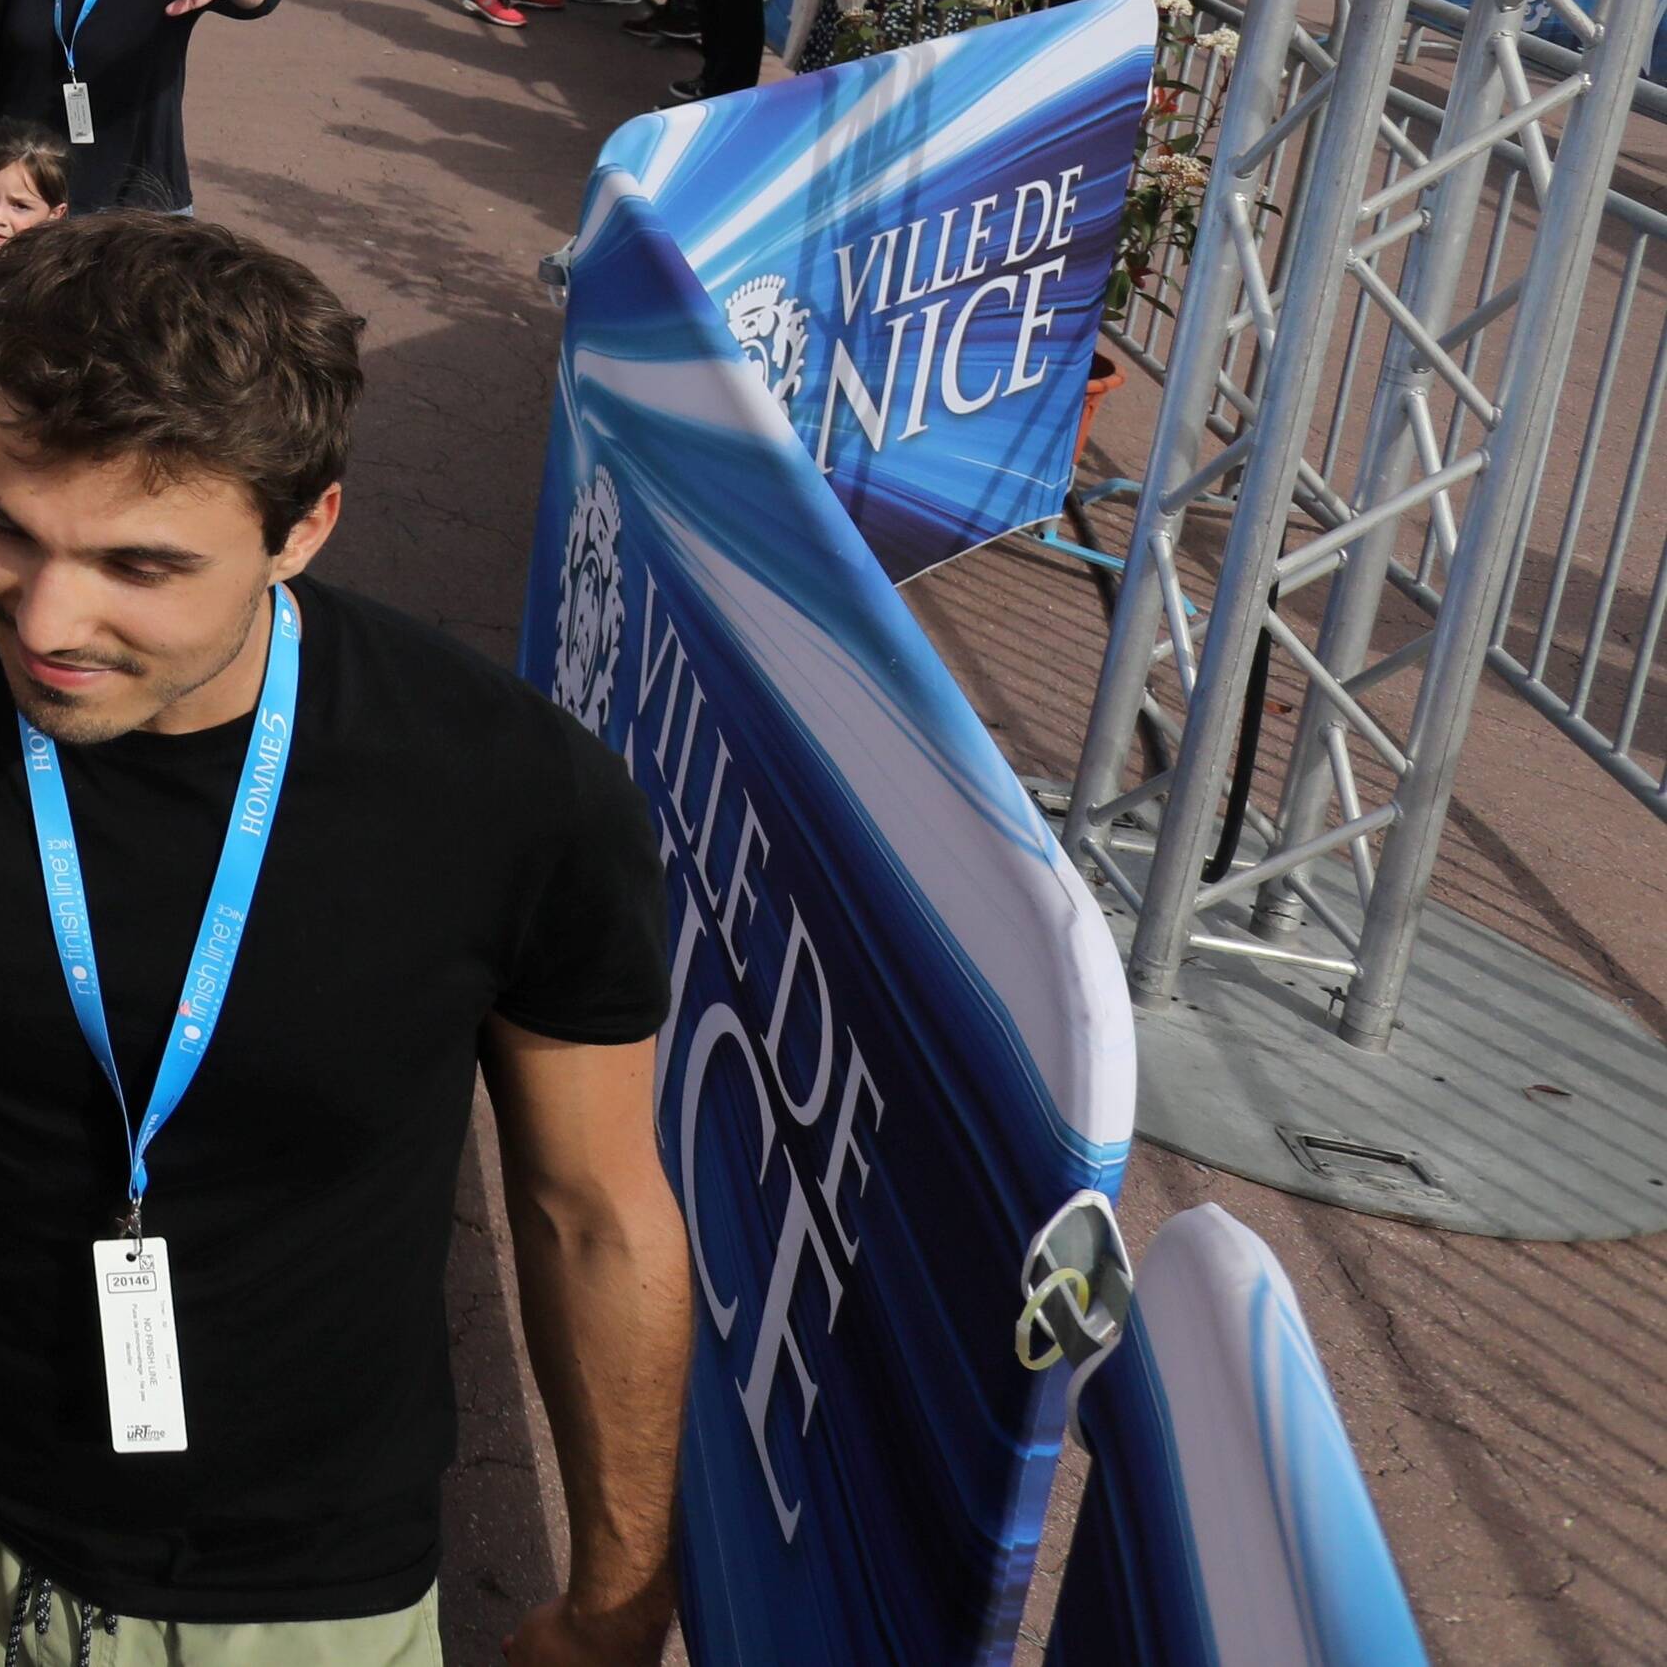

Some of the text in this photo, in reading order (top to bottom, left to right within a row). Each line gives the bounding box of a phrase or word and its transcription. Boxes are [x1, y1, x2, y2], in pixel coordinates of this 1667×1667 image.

[832, 164, 1085, 329] VILLE DE
[816, 255, 1067, 478] NICE
[240, 706, 288, 836] HOMME 5
[634, 562, 771, 982] VILLE
[45, 835, 72, 852] NICE
[45, 855, 91, 996] no finish line
[216, 903, 245, 923] NICE
[179, 1023, 202, 1055] no
[206, 917, 233, 961] line
[759, 894, 886, 1266] DE
[113, 1274, 150, 1288] 20146
[143, 1317, 159, 1387] NO FINISH LINE
